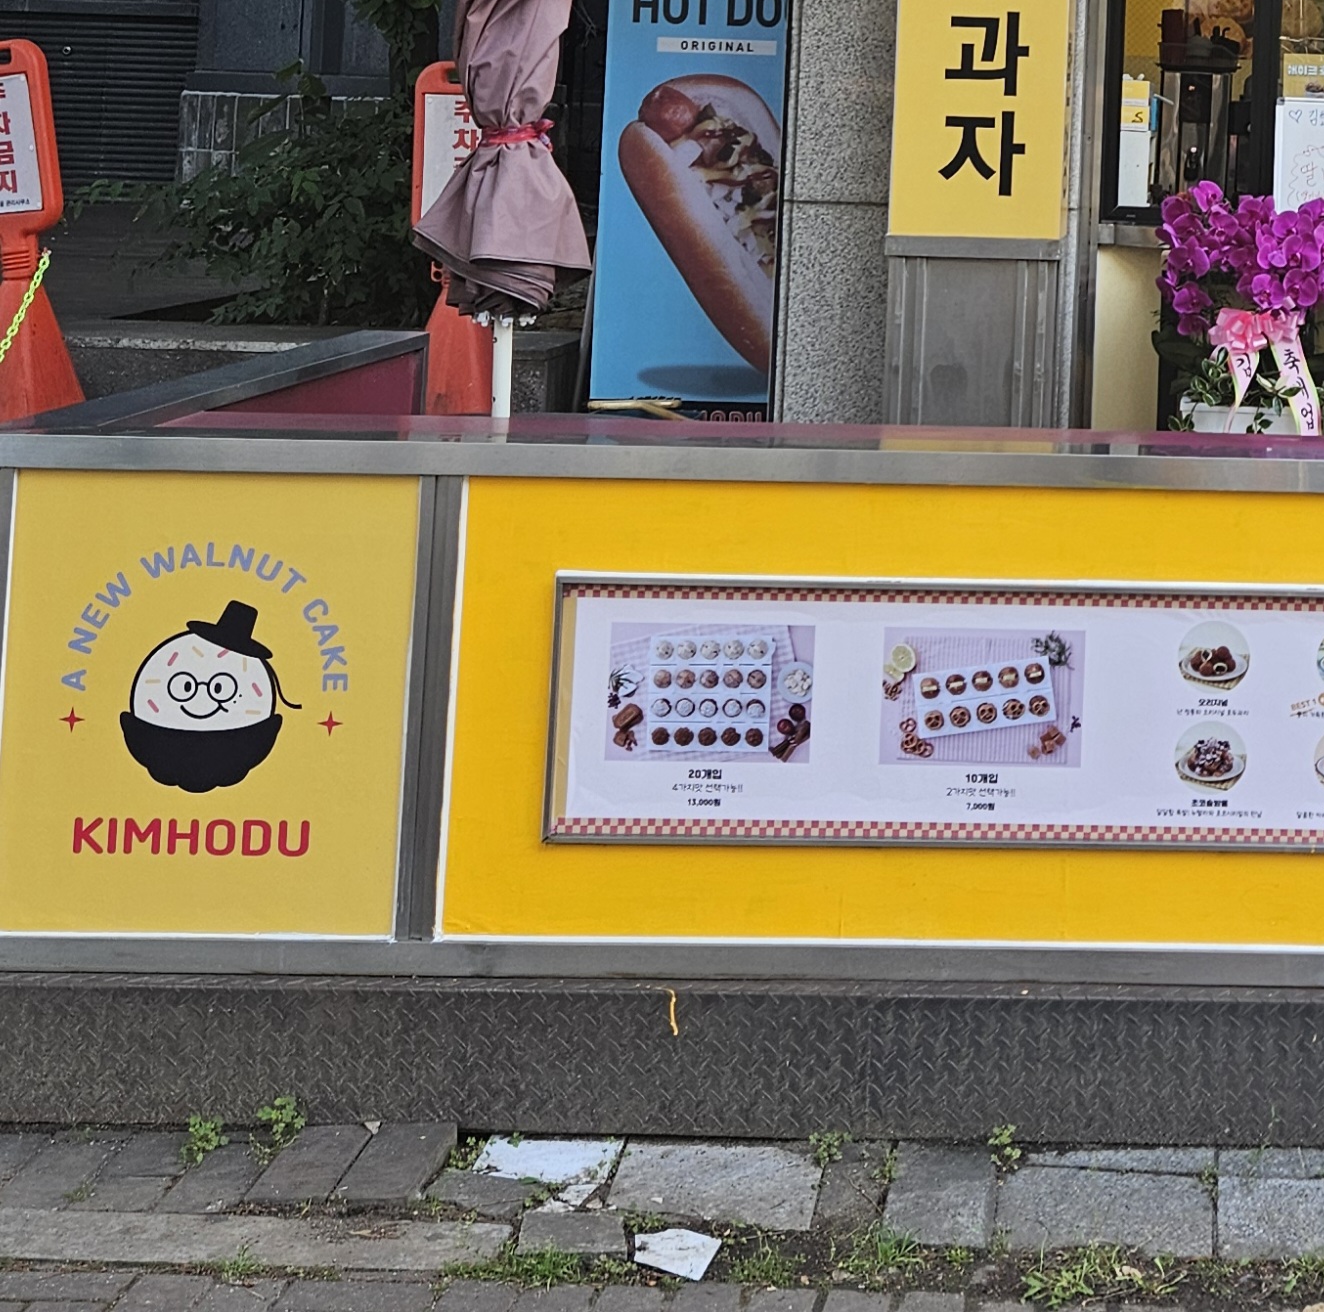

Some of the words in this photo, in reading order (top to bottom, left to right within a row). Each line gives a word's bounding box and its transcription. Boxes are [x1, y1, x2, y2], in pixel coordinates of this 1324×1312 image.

[680, 40, 755, 53] ORIGINAL
[140, 541, 307, 593] WALNUT
[68, 572, 131, 655] NEW
[303, 598, 348, 692] CAKE
[61, 669, 87, 691] A
[688, 769, 722, 780] 20개입
[965, 773, 998, 784] 10개입
[72, 817, 310, 857] KIMHODU
